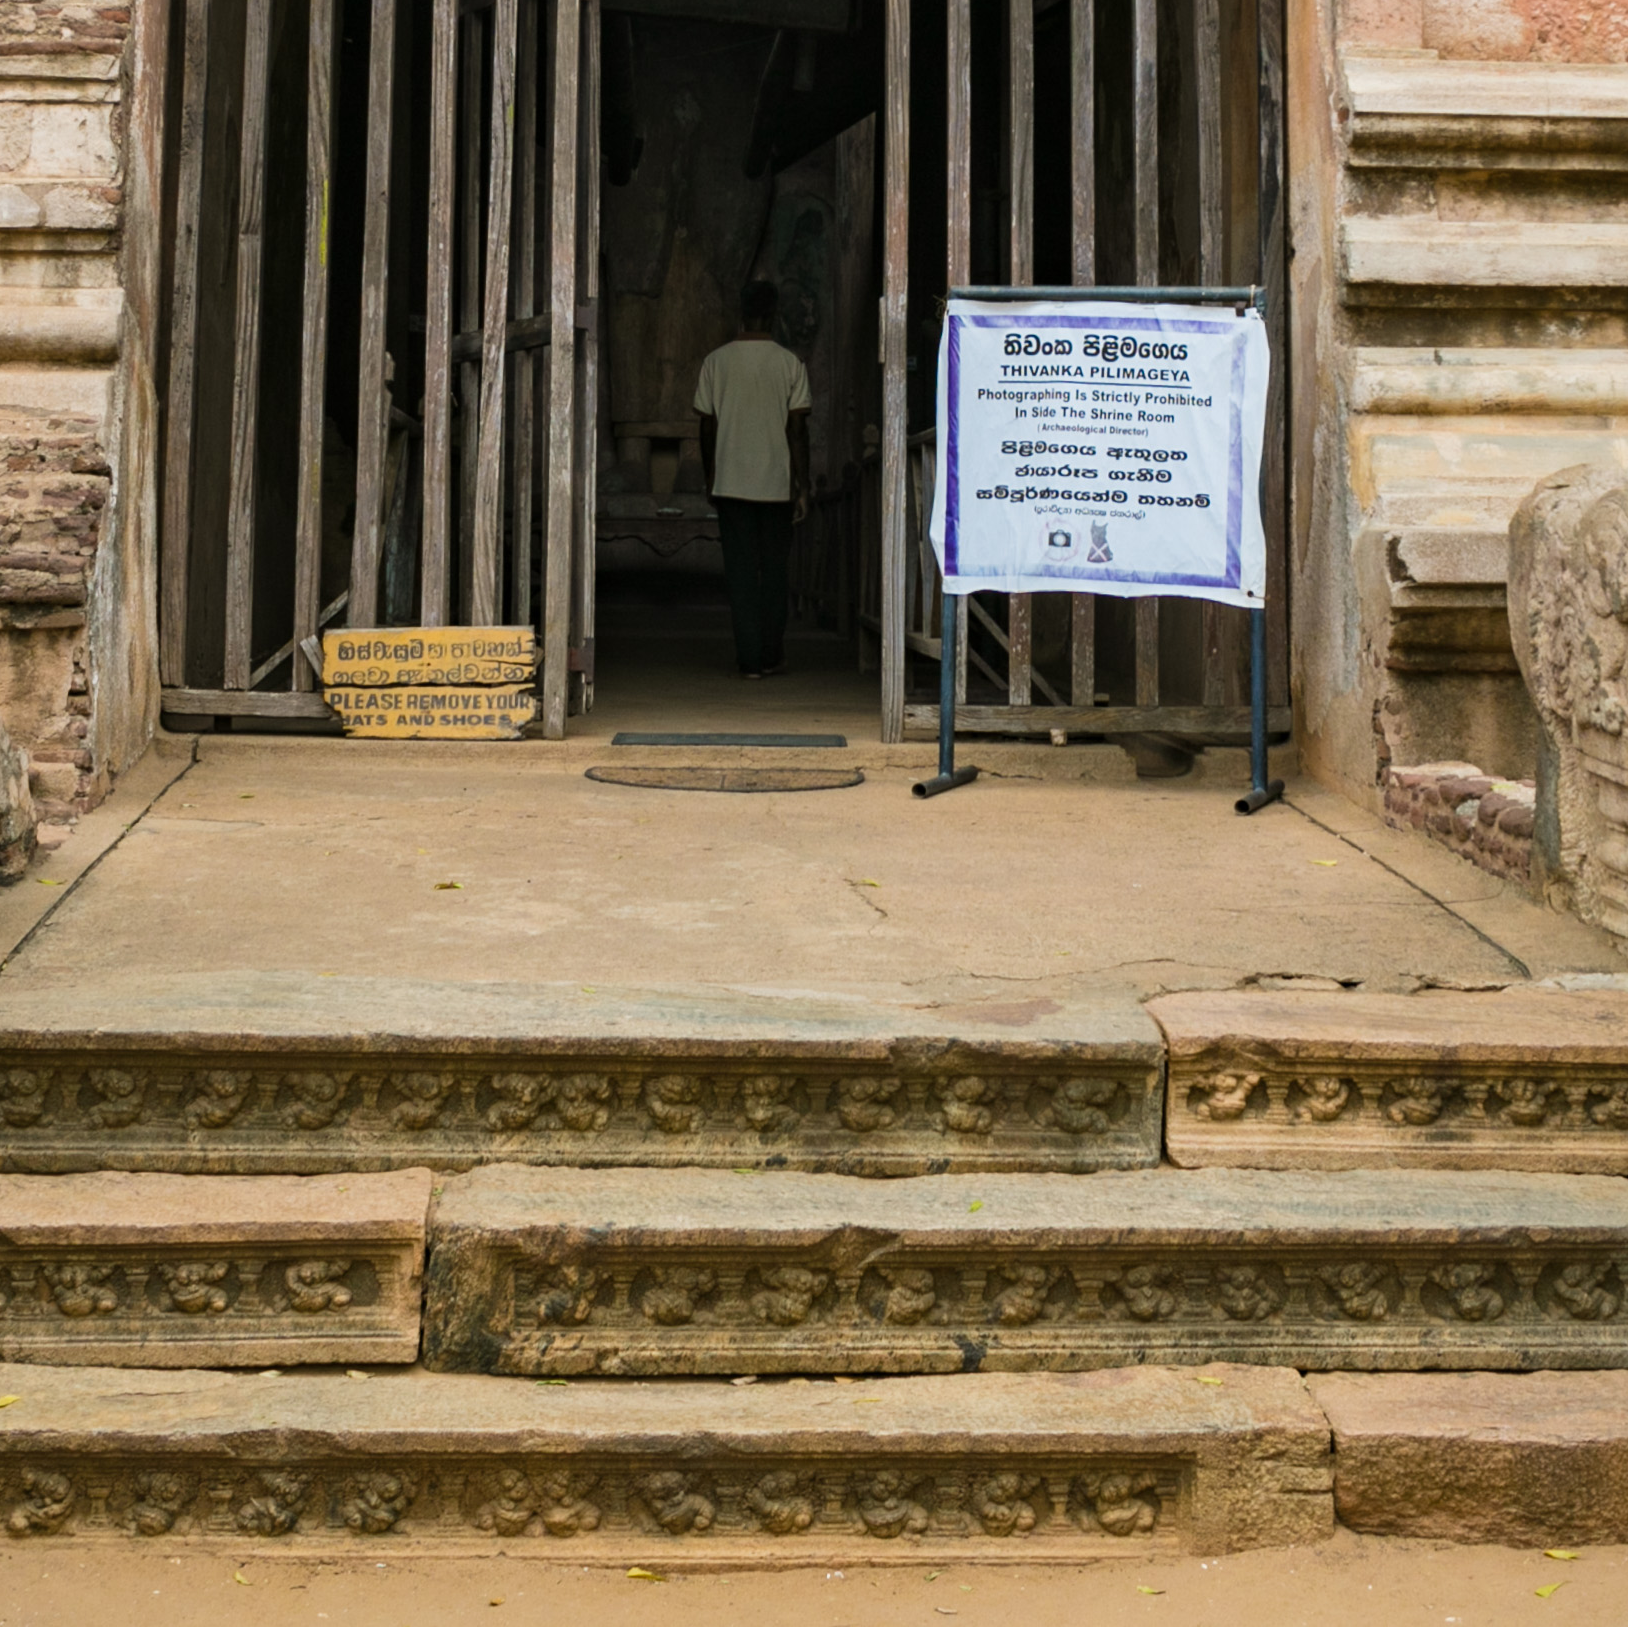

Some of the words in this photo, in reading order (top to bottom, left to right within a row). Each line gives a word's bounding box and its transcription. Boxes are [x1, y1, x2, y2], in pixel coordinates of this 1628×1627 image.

[1004, 333, 1073, 356] තිවංක
[1083, 334, 1188, 362] පිළිමගෙය
[1000, 365, 1084, 377] THIVANKA
[1090, 367, 1190, 382] PILIMAGEYA
[977, 389, 1071, 403] Photographing
[1075, 389, 1087, 401] Is
[1092, 390, 1141, 406] Strictly
[1145, 393, 1212, 407] Prohibited
[1015, 407, 1027, 418] In
[1031, 406, 1056, 418] Side
[1061, 406, 1086, 419] The
[1090, 408, 1133, 421] Shrine
[1137, 410, 1175, 423] Room
[330, 693, 403, 710] PLEASE
[406, 694, 482, 710] REMOVE
[485, 693, 530, 710] YOUR
[396, 714, 435, 726] AND
[439, 714, 512, 726] SHOES
